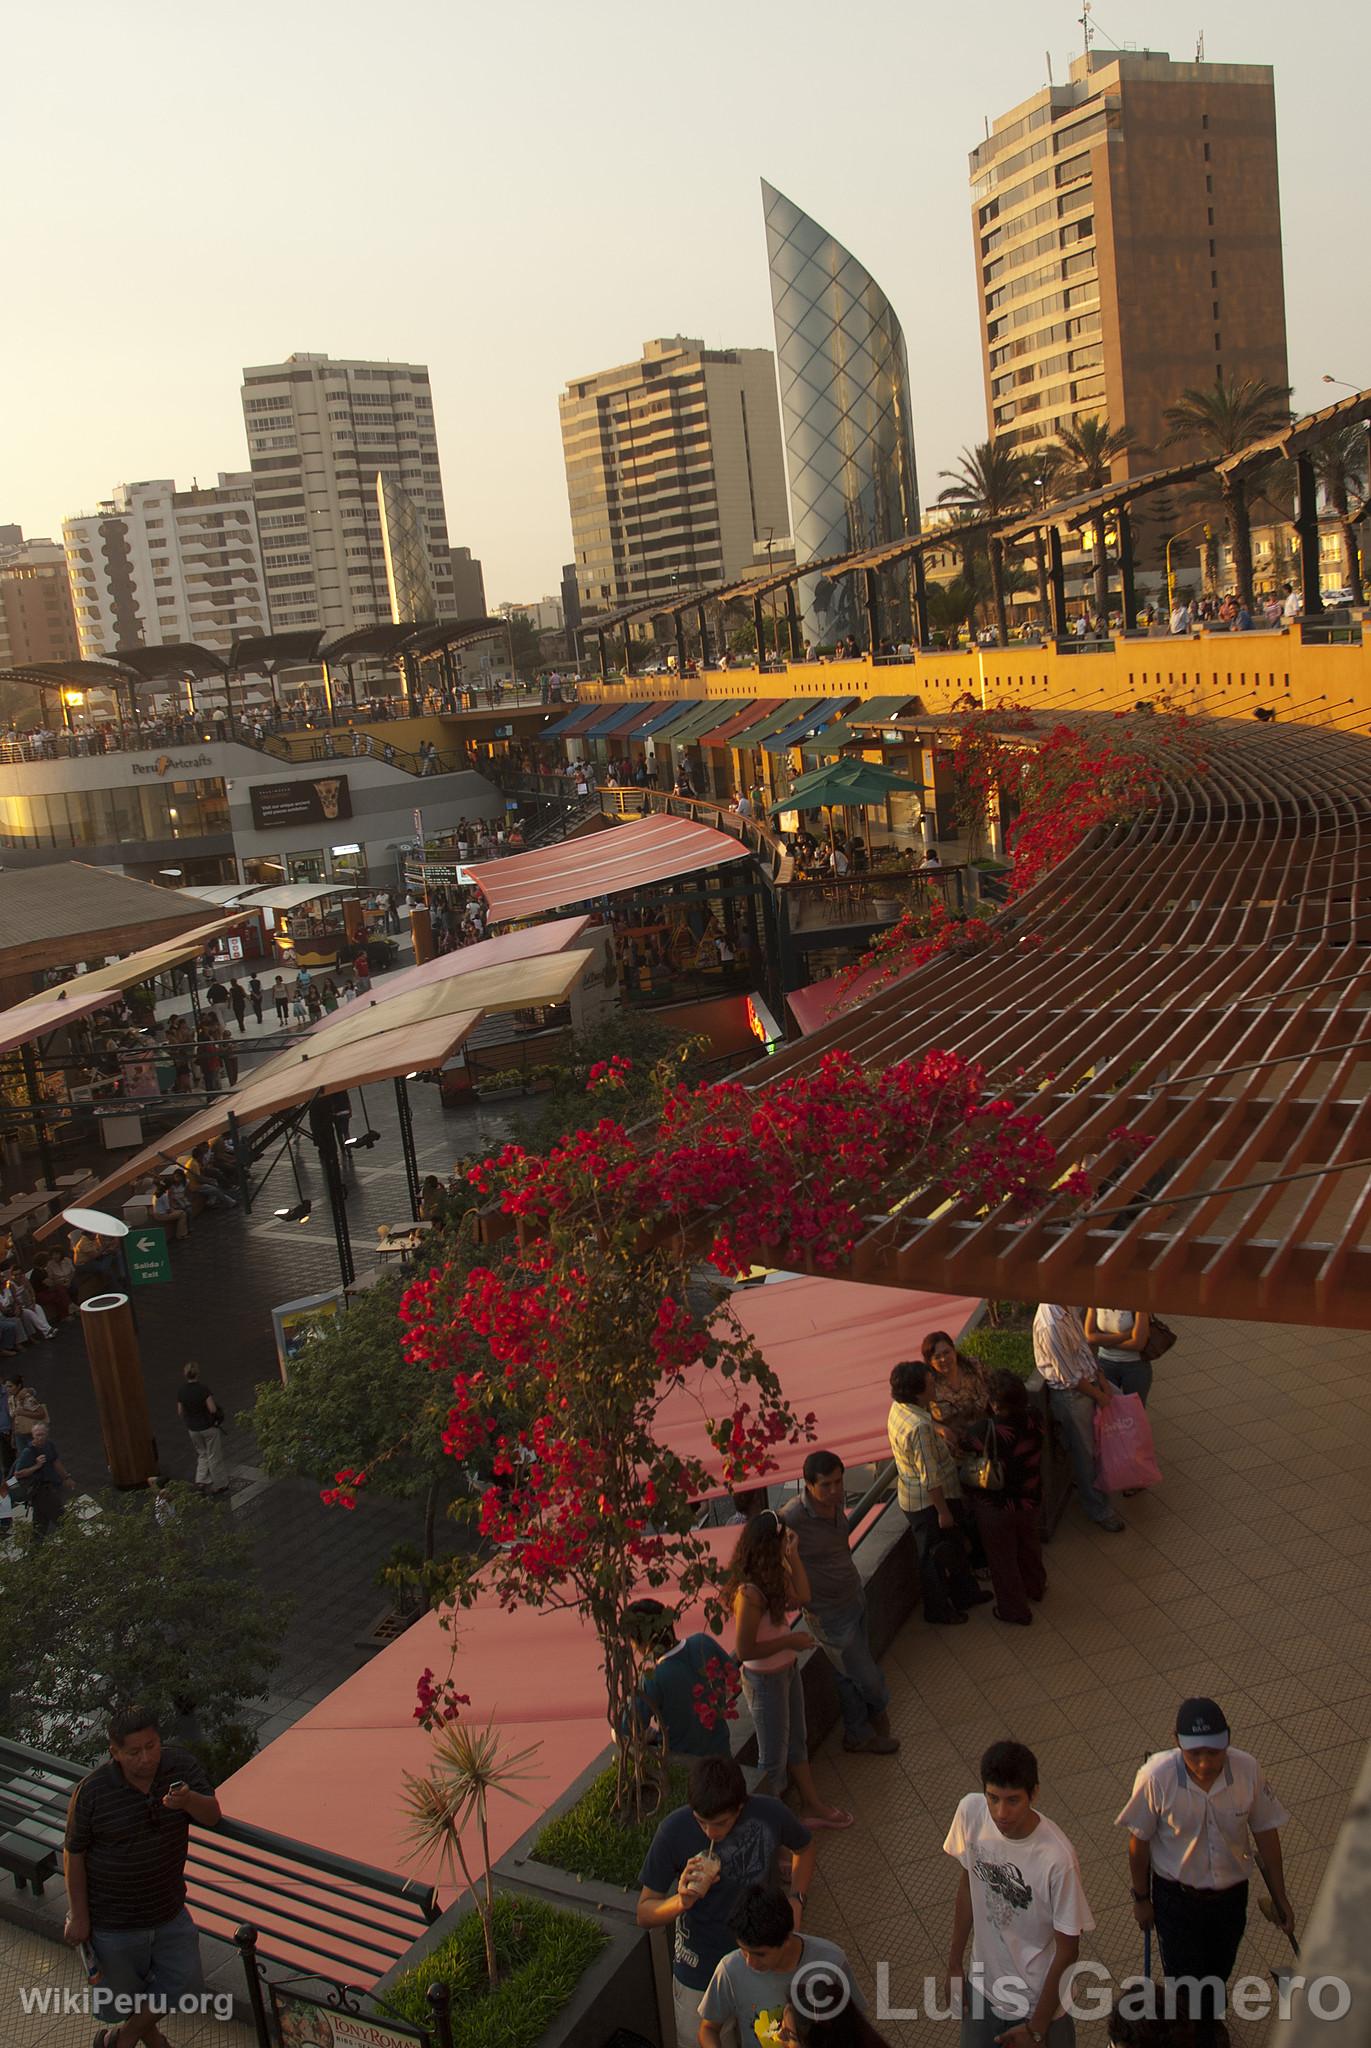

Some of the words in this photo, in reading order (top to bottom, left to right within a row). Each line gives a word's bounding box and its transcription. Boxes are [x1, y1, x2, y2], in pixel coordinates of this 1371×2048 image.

[131, 763, 158, 775] Peru
[166, 752, 212, 770] Artcrafts
[134, 1261, 159, 1270] Salida
[142, 1271, 159, 1279] Exit
